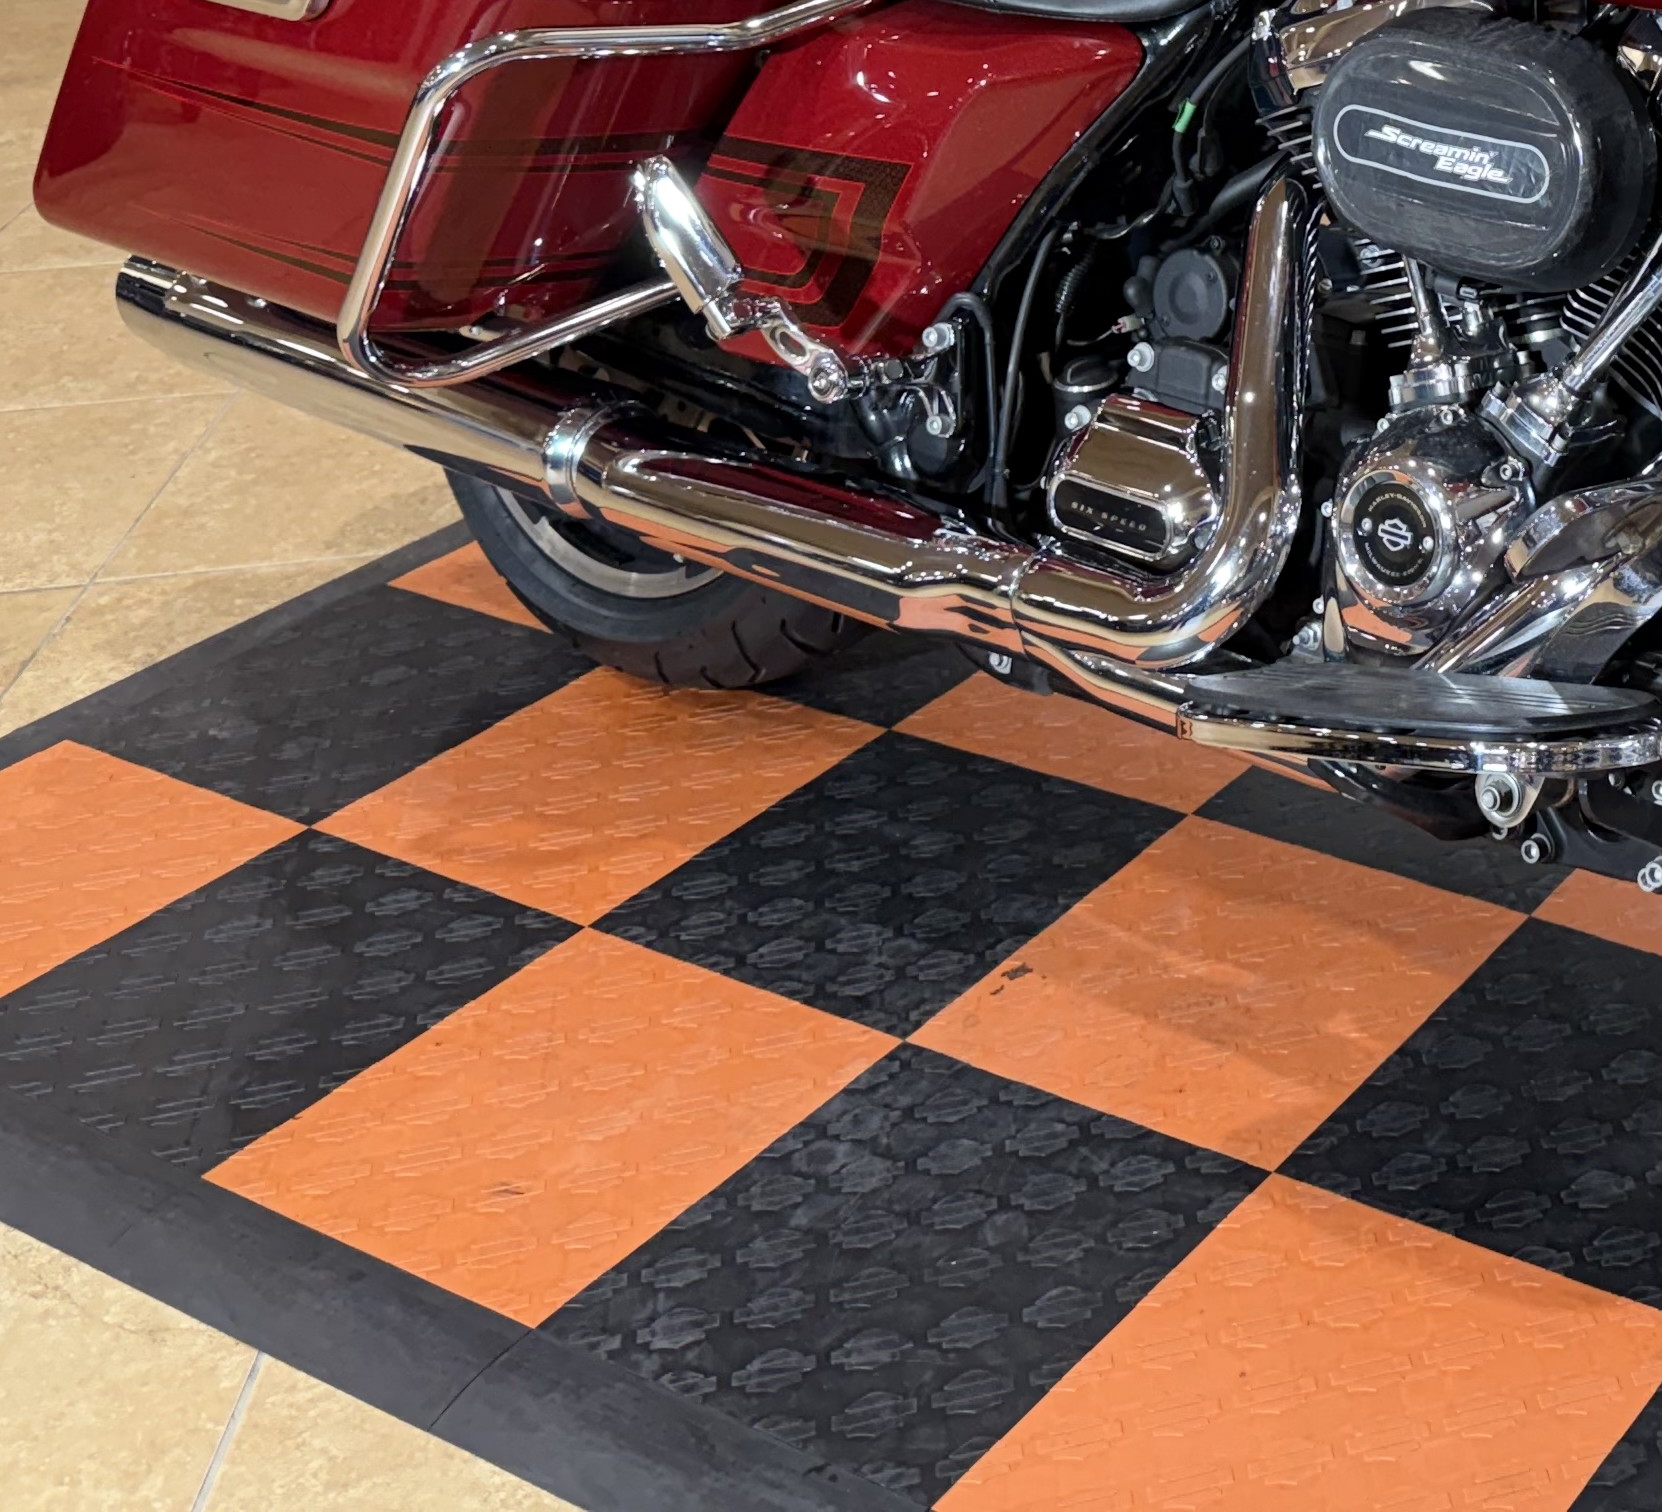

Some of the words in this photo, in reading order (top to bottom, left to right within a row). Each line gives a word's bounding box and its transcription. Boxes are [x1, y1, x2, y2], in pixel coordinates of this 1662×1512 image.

[1433, 155, 1514, 185] Eagle
[1070, 501, 1094, 515] SIX
[1100, 512, 1148, 531] SPEED
[1367, 492, 1427, 528] HARLEY-DAVIDSON
